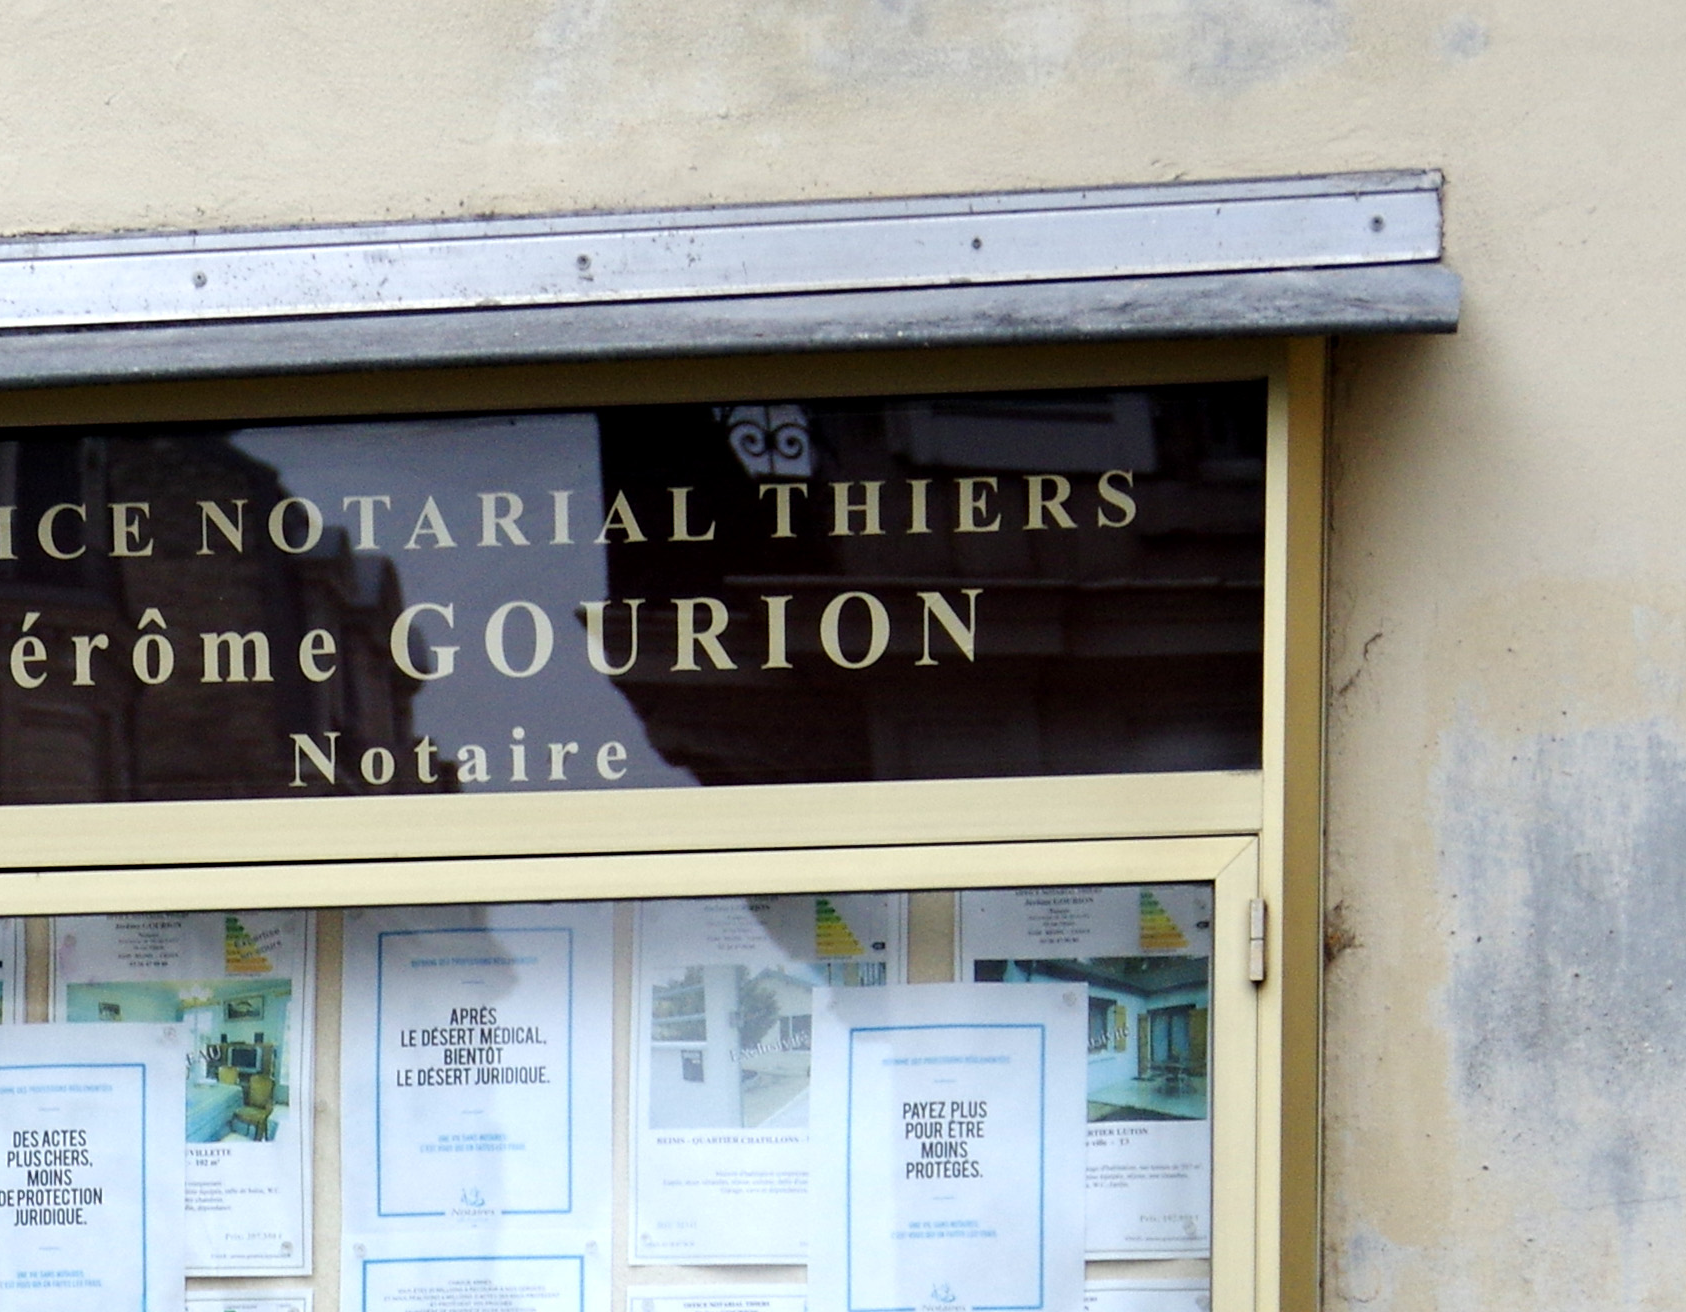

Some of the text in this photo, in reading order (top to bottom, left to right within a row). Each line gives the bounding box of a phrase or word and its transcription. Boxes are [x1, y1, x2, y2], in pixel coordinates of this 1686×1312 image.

[197, 489, 718, 556] NOTARIAL
[758, 469, 1140, 539] THIERS
[389, 588, 984, 681] GOURION
[289, 731, 629, 789] Notaire
[450, 1005, 497, 1025] APRÈS
[401, 1030, 417, 1047] LE
[422, 1026, 474, 1047] DÉSERT
[444, 1046, 504, 1065] BIENTÔT
[396, 1066, 551, 1086] LE DÉSERT JURIDIQUE.
[903, 1101, 987, 1120] PAYEZ PLUS
[905, 1118, 985, 1139] POUR ÊTRE
[13, 1130, 87, 1148] DES ACTES
[7, 1149, 93, 1168] PLUS CHERS,
[921, 1141, 968, 1159] MOINS
[27, 1169, 72, 1186] MOINS
[906, 1159, 983, 1179] PROTÉGÉS.
[17, 1188, 103, 1206] PROTECTION
[14, 1208, 87, 1226] JURIDIQUE.
